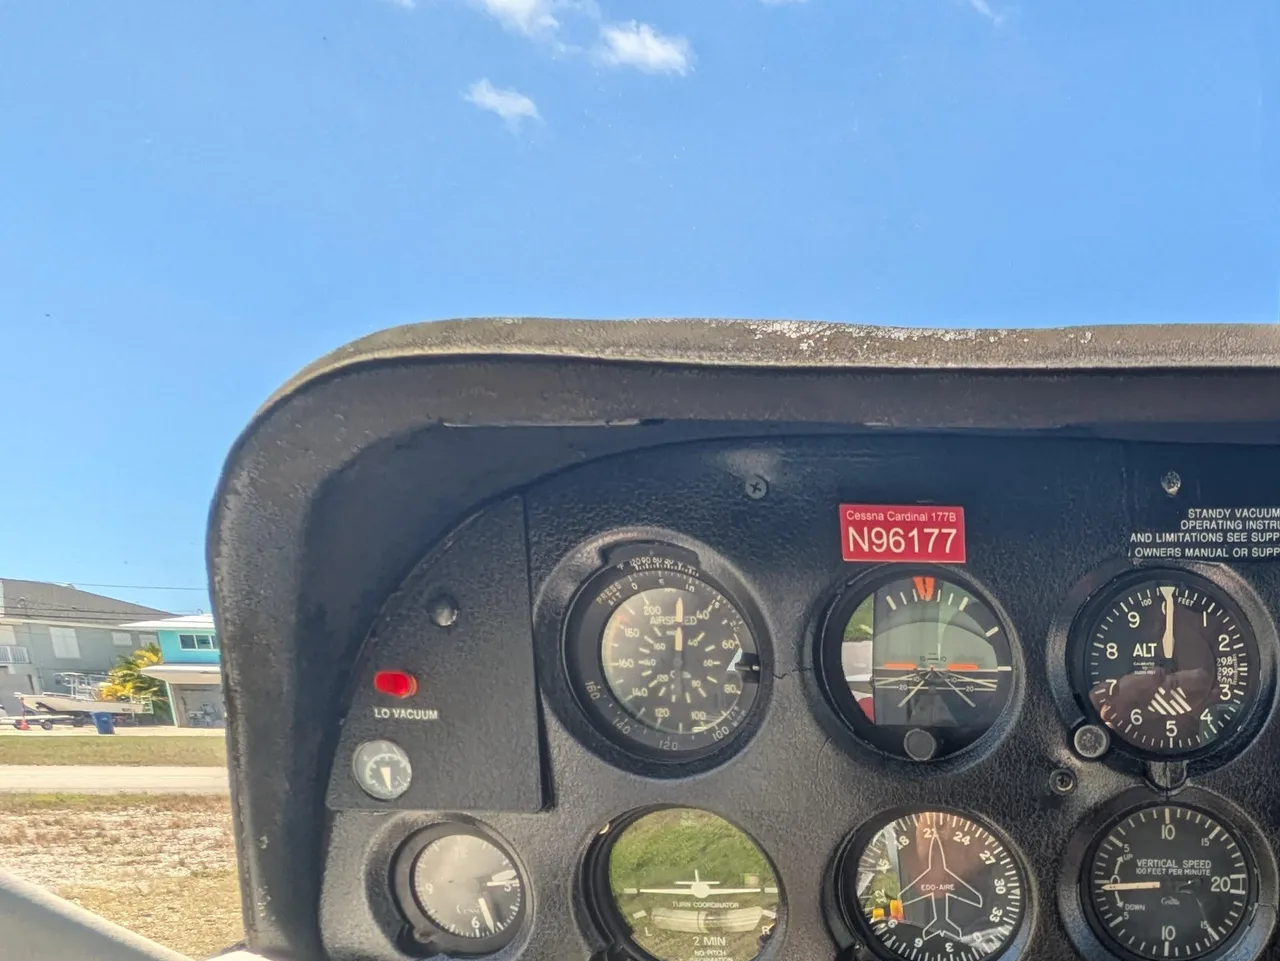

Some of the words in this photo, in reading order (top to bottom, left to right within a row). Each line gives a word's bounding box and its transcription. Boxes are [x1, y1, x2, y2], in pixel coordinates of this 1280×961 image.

[846, 511, 884, 521] Cessna
[887, 511, 927, 522] Cardinal
[931, 512, 956, 522] 177B
[1188, 508, 1230, 518] STANDY
[1235, 508, 1280, 518] VACUUM
[1181, 520, 1242, 530] OPERATING
[848, 526, 957, 553] N96177
[1130, 533, 1152, 543] AND
[1156, 533, 1223, 542] LIMITATIONS
[1227, 533, 1248, 542] SEE
[1135, 548, 1181, 557] OWNERS
[1185, 548, 1229, 557] MANUAL
[1233, 548, 1248, 557] OR
[1178, 597, 1194, 607] FEET
[1128, 612, 1140, 628] 9
[1219, 634, 1230, 651] 2
[1106, 643, 1118, 659] 8
[1133, 643, 1157, 657] ALT
[1105, 679, 1117, 695] 7
[1219, 684, 1231, 701] 3
[375, 708, 389, 719] LO
[393, 708, 438, 720] VACUUM
[1131, 709, 1143, 725] 6
[1200, 708, 1213, 724] 4
[1166, 721, 1177, 737] 5
[953, 831, 971, 845] 24
[1162, 825, 1175, 840] 10
[979, 850, 996, 865] 27
[1137, 859, 1178, 868] VERTICAL
[1183, 860, 1212, 868] SPEED
[1211, 876, 1230, 892] 20
[644, 927, 652, 936] L
[1162, 926, 1175, 940] 10
[704, 937, 726, 945] MIN
